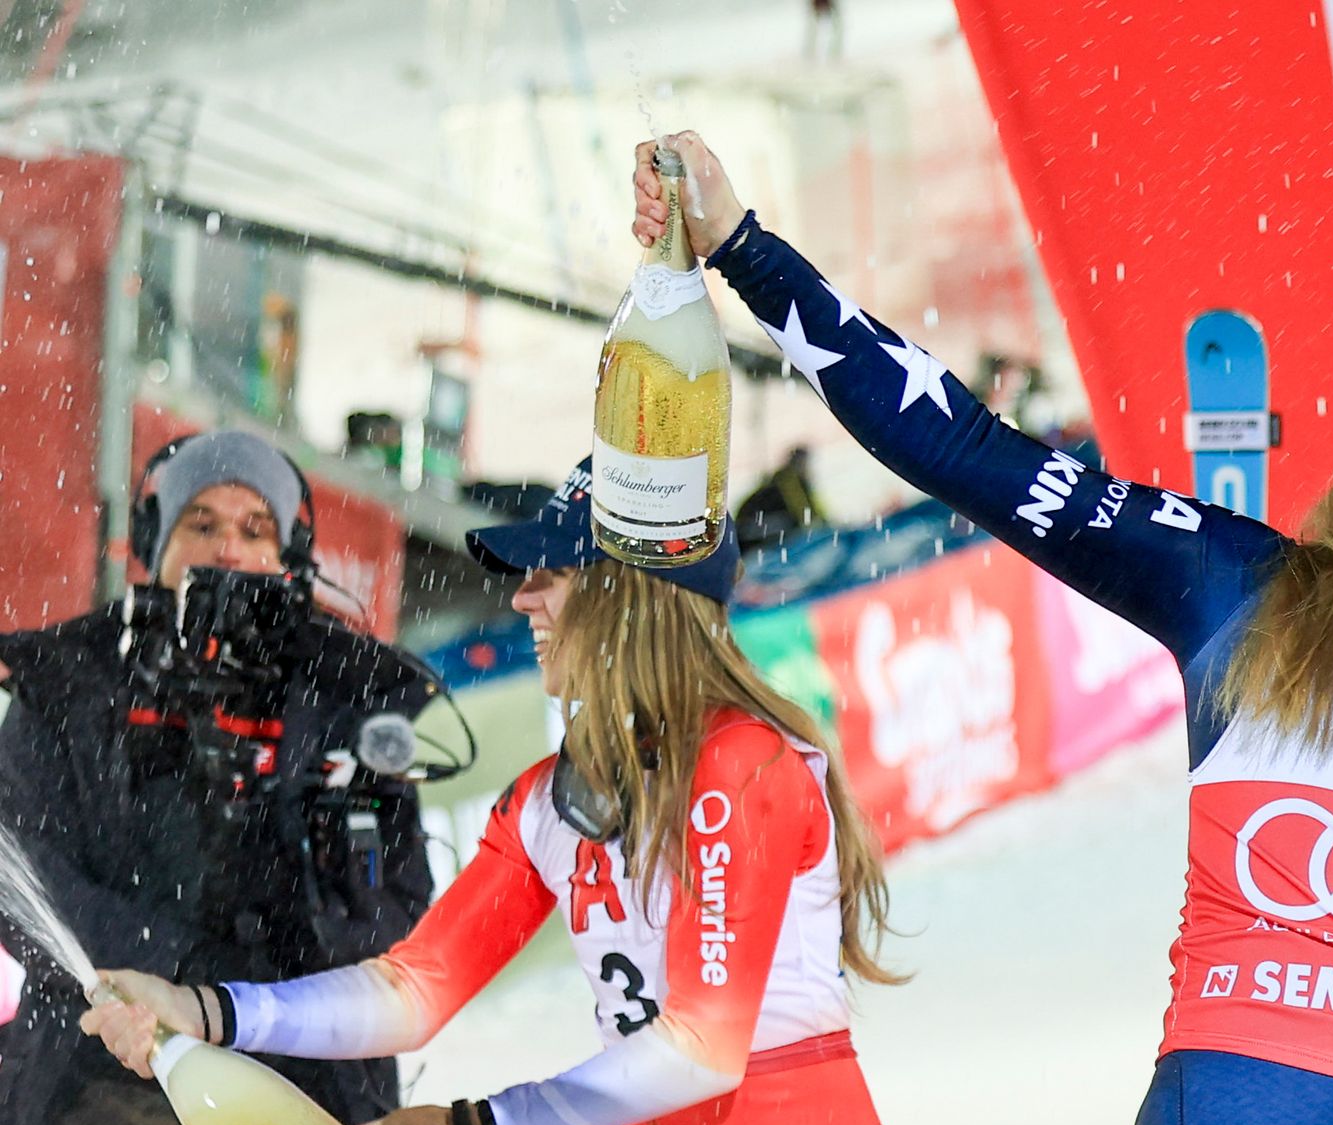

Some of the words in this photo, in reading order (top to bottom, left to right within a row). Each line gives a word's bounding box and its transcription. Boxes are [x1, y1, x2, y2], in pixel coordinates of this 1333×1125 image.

[602, 465, 687, 499] Schlumberger
[1088, 477, 1131, 529] YOTA
[701, 841, 736, 987] Sunrise
[600, 952, 660, 1037] 3
